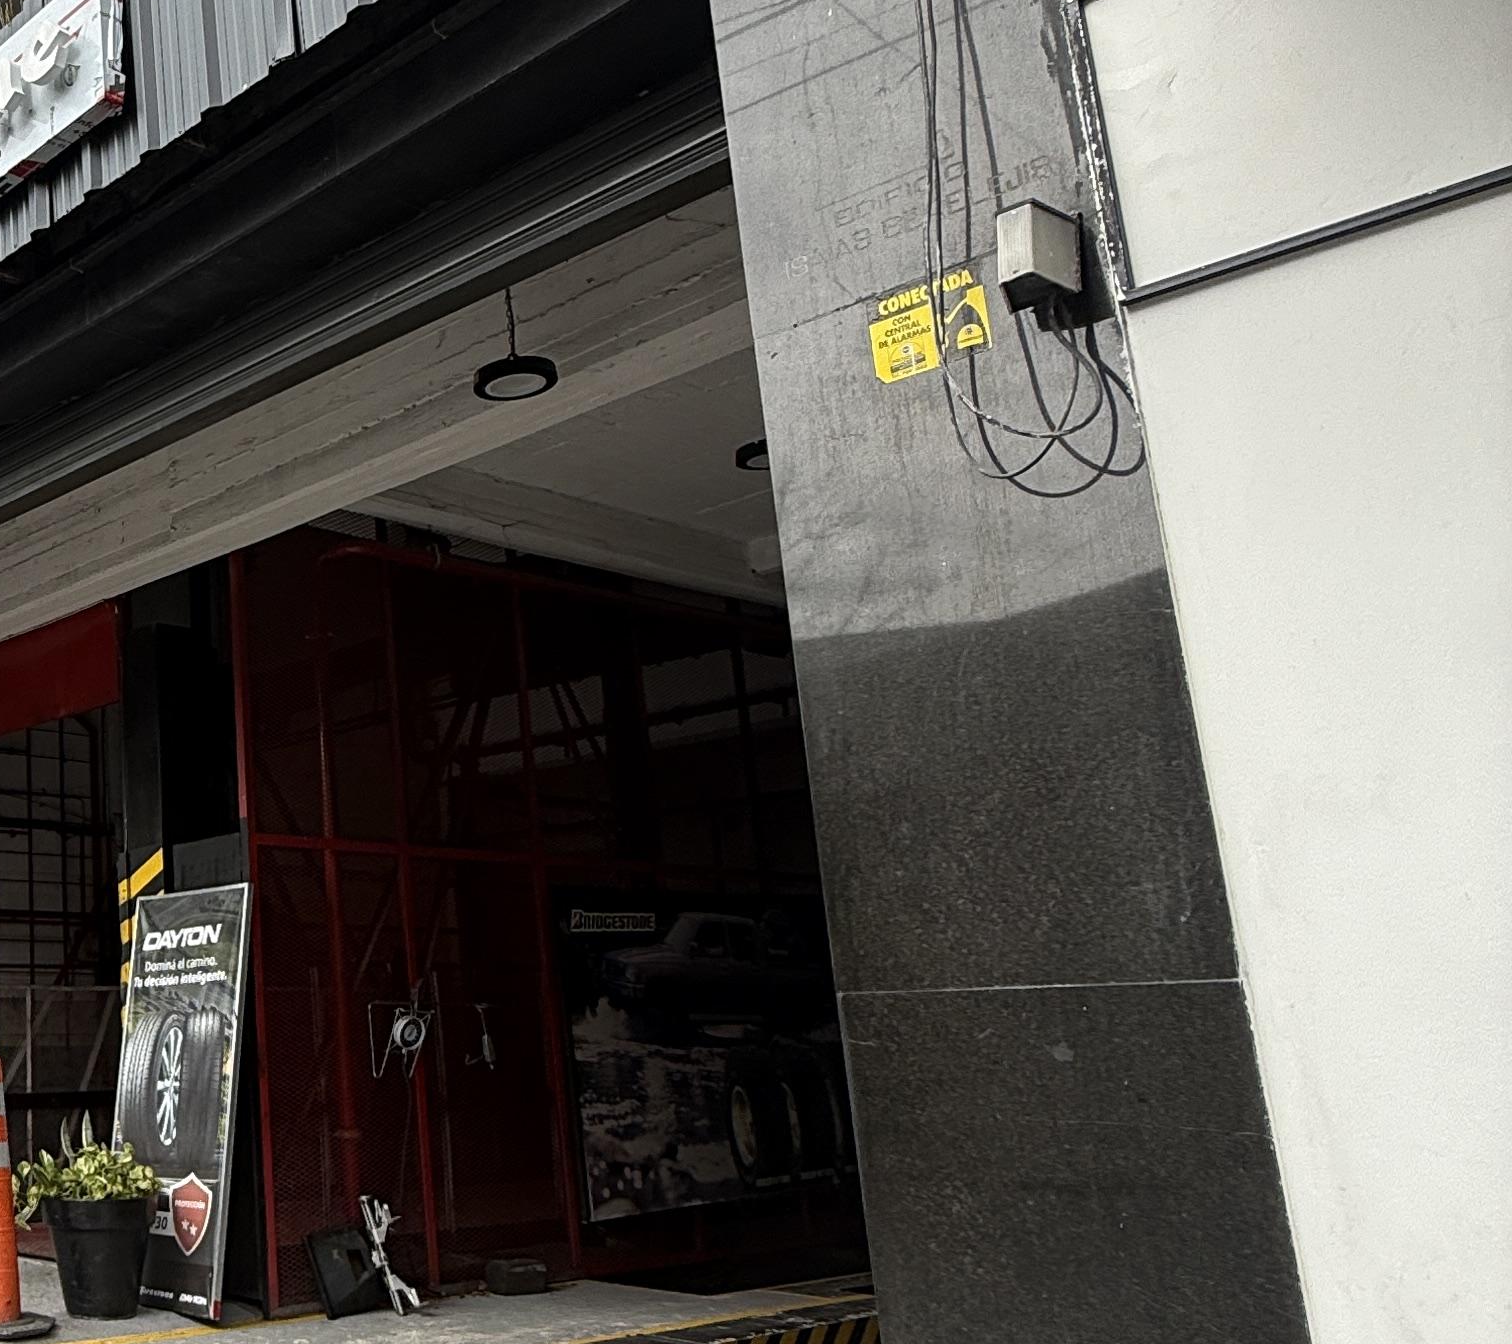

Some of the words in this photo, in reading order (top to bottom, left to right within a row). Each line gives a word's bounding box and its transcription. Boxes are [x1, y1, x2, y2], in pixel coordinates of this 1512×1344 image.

[836, 160, 965, 227] EDIFICO
[885, 319, 921, 337] CENTRAL
[892, 314, 911, 326] CON
[891, 324, 931, 345] ALARMAS
[571, 910, 655, 931] BRIDGESTONE
[142, 923, 223, 951] DAYTON
[144, 974, 179, 987] decisión
